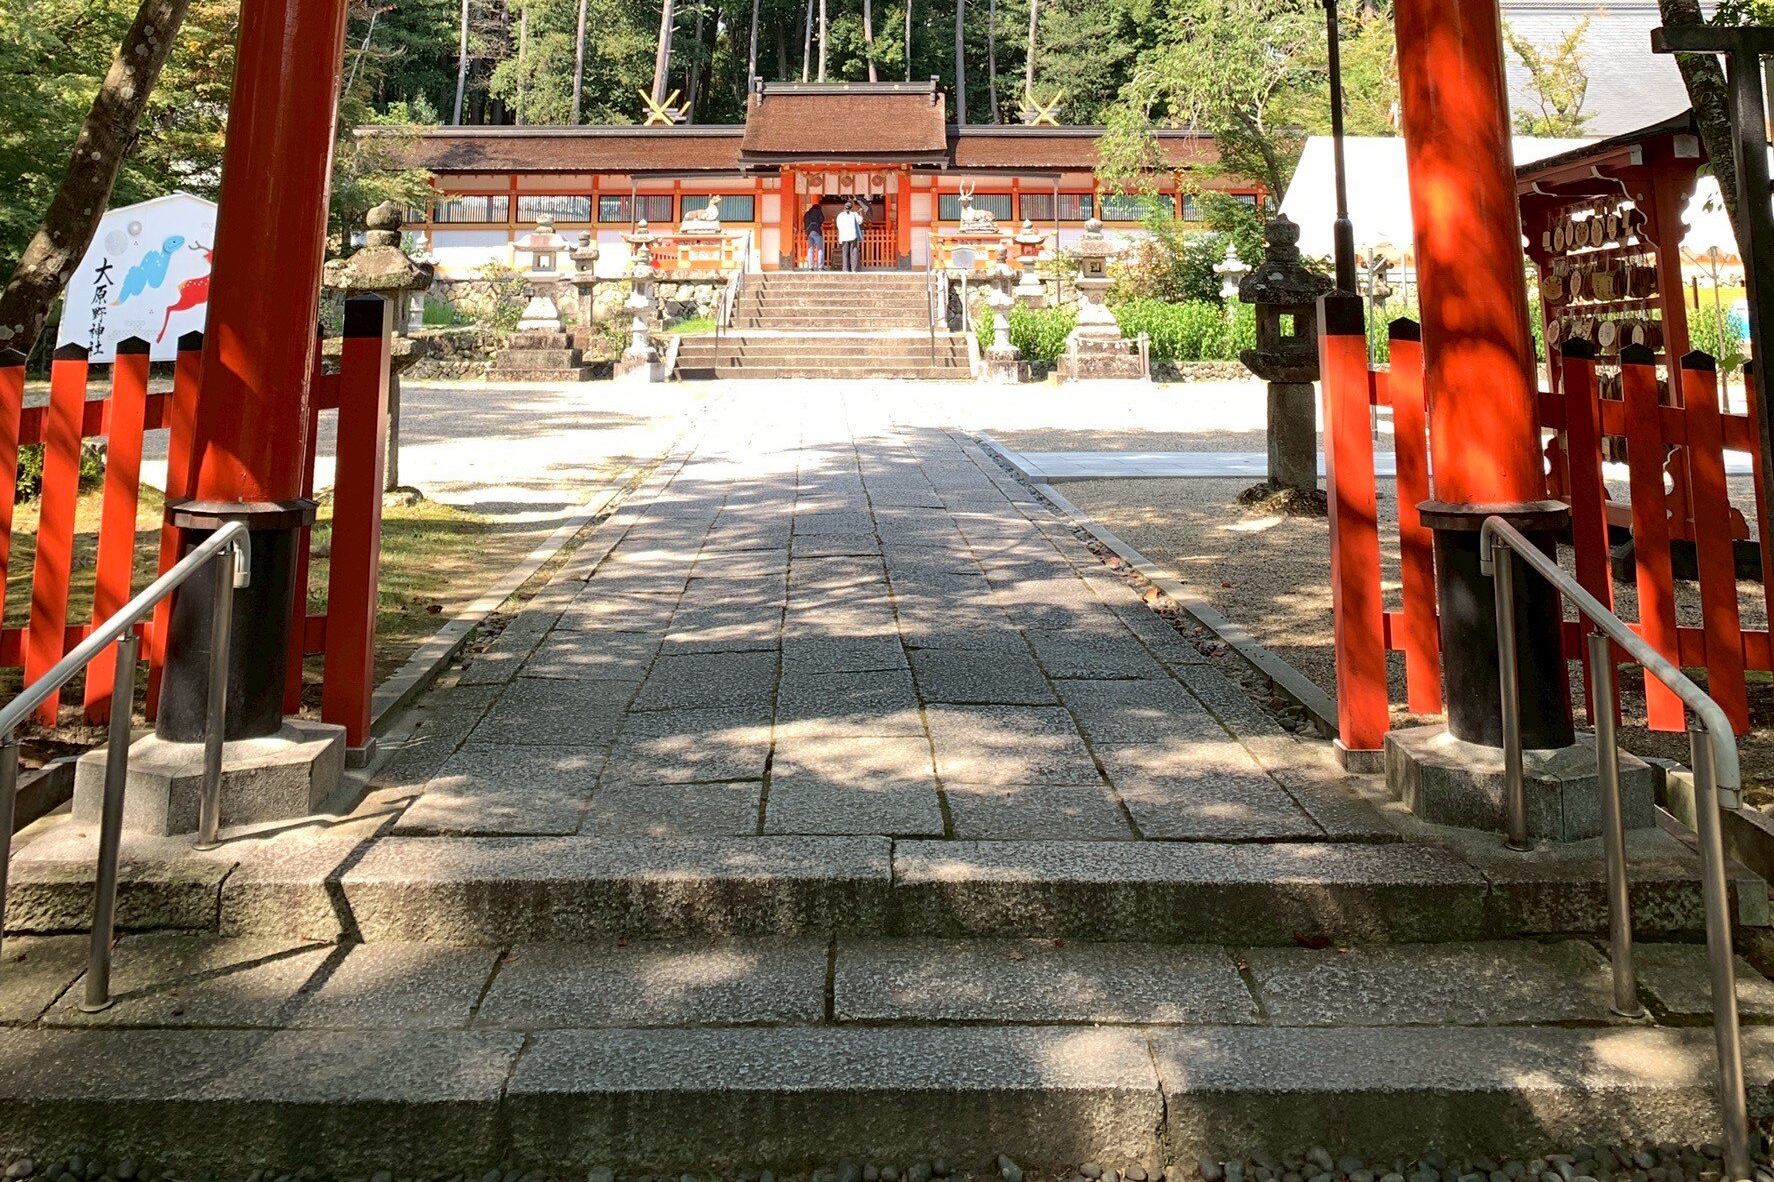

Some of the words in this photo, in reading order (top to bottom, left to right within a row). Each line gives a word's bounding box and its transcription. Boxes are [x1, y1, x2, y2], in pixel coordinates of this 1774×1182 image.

[88, 257, 114, 356] 大原野神社
